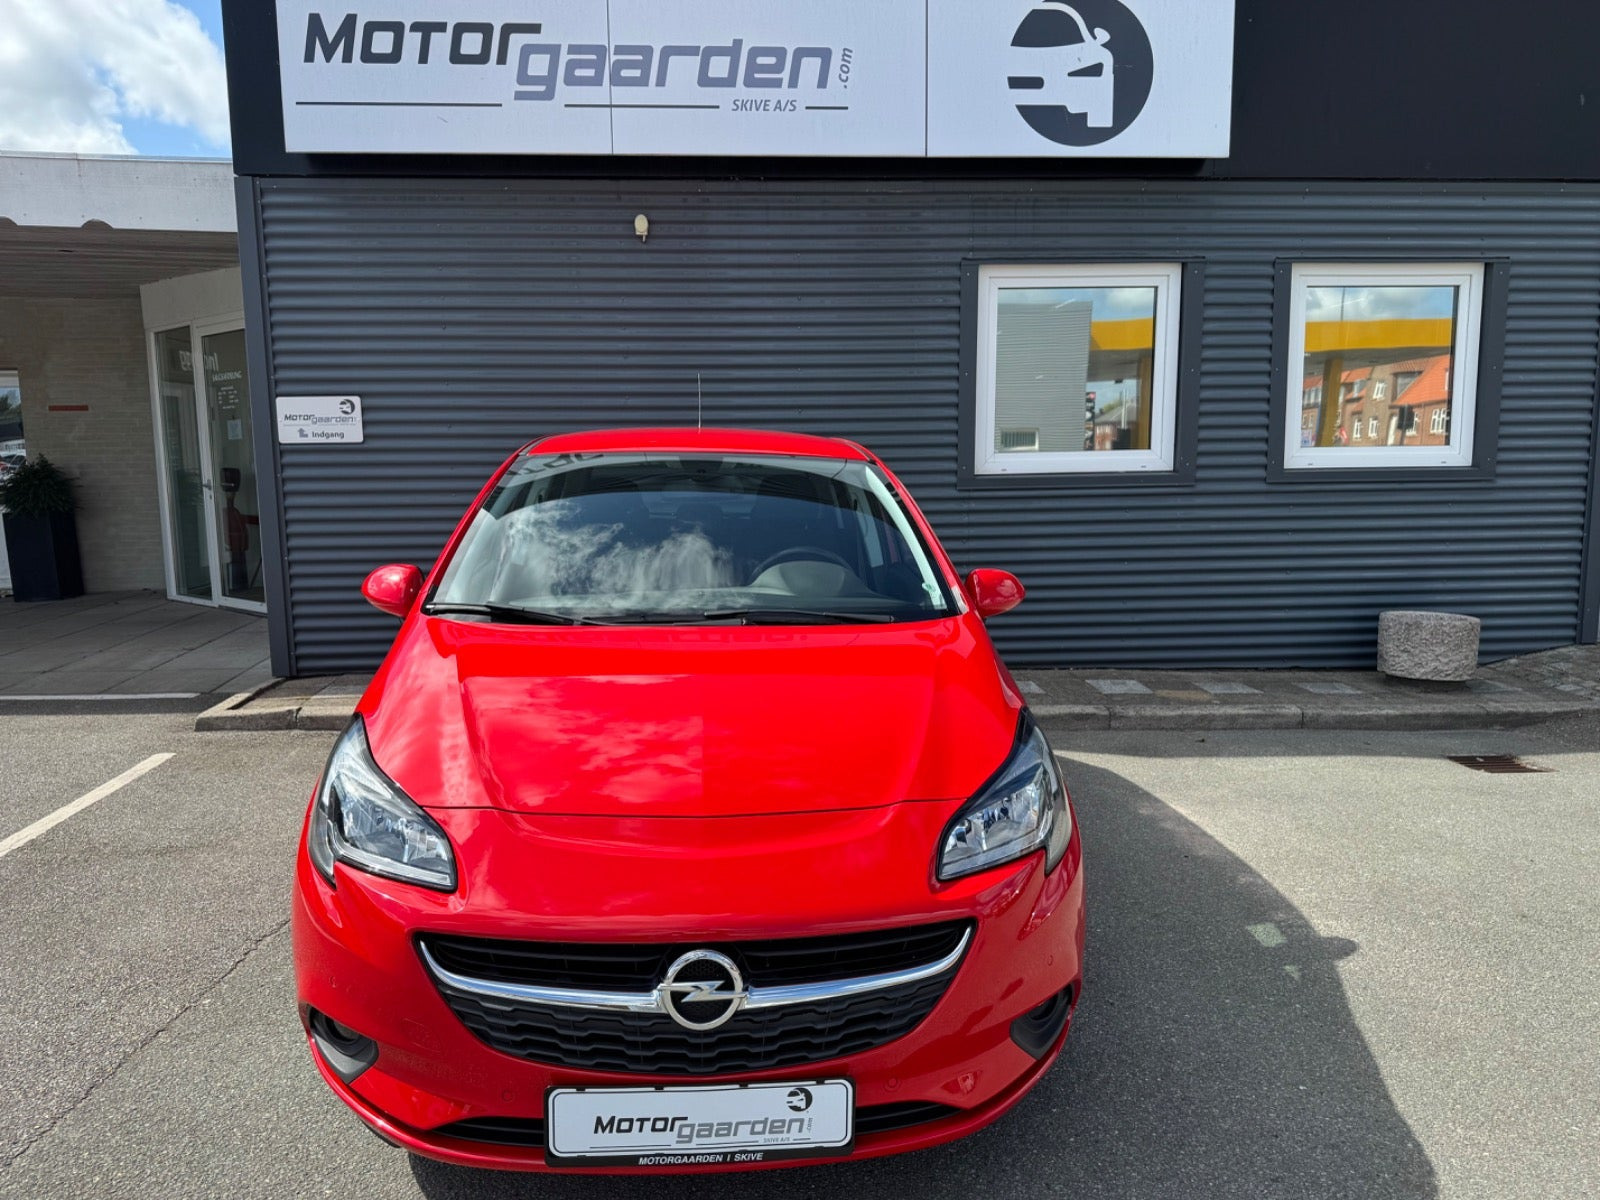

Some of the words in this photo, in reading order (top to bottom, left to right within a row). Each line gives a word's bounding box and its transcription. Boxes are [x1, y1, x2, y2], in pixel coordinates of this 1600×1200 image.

[731, 98, 771, 112] SKIVE
[773, 99, 797, 112] A/S
[312, 430, 345, 439] Indgang
[638, 1153, 724, 1166] MOTORGAARDEN
[733, 1152, 764, 1162] SKIVE
